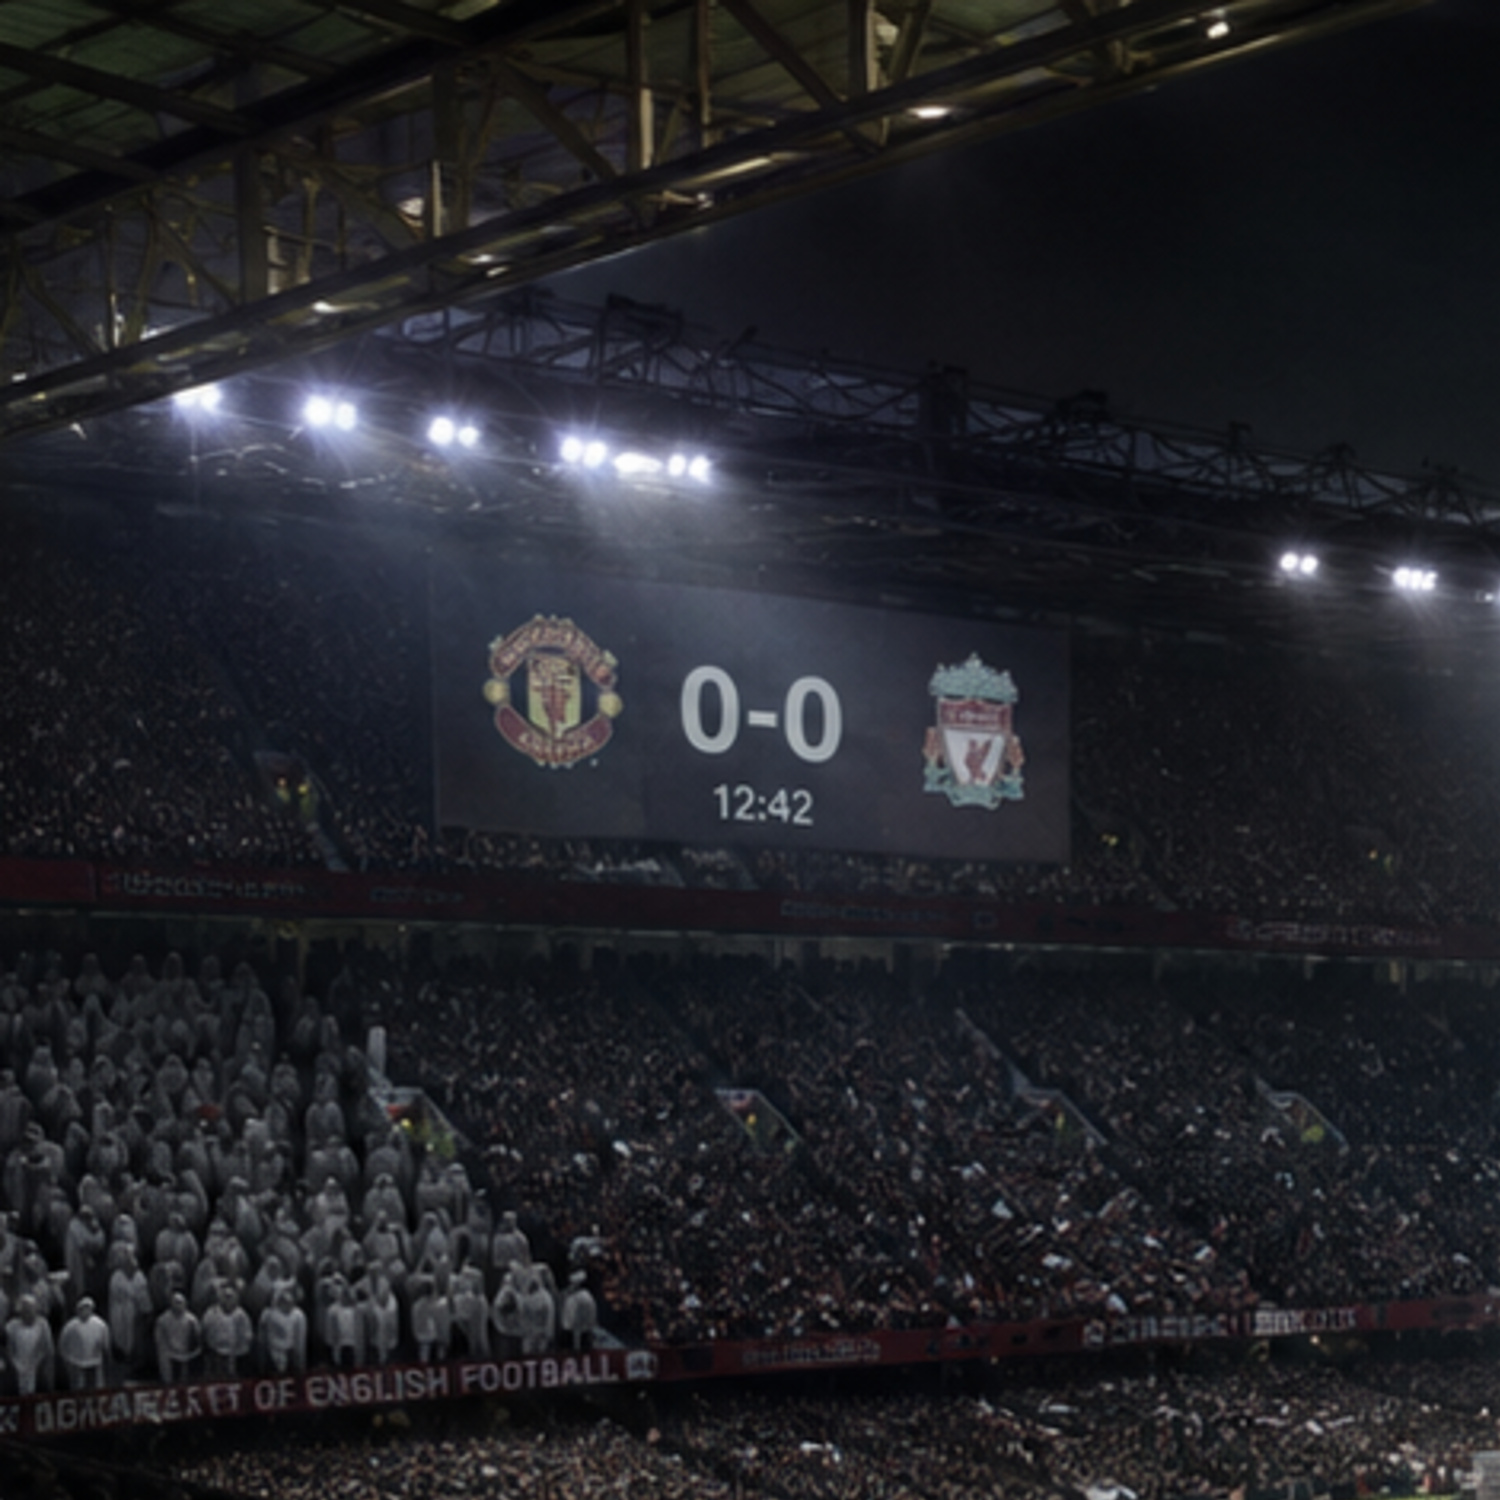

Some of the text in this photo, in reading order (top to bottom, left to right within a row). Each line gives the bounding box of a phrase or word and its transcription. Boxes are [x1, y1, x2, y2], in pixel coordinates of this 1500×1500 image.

[681, 665, 842, 763] 0-0
[713, 783, 814, 826] 12:42
[253, 1377, 297, 1411] OF
[305, 1366, 450, 1408] ENGLISH
[461, 1354, 620, 1395] FOOTBALL
